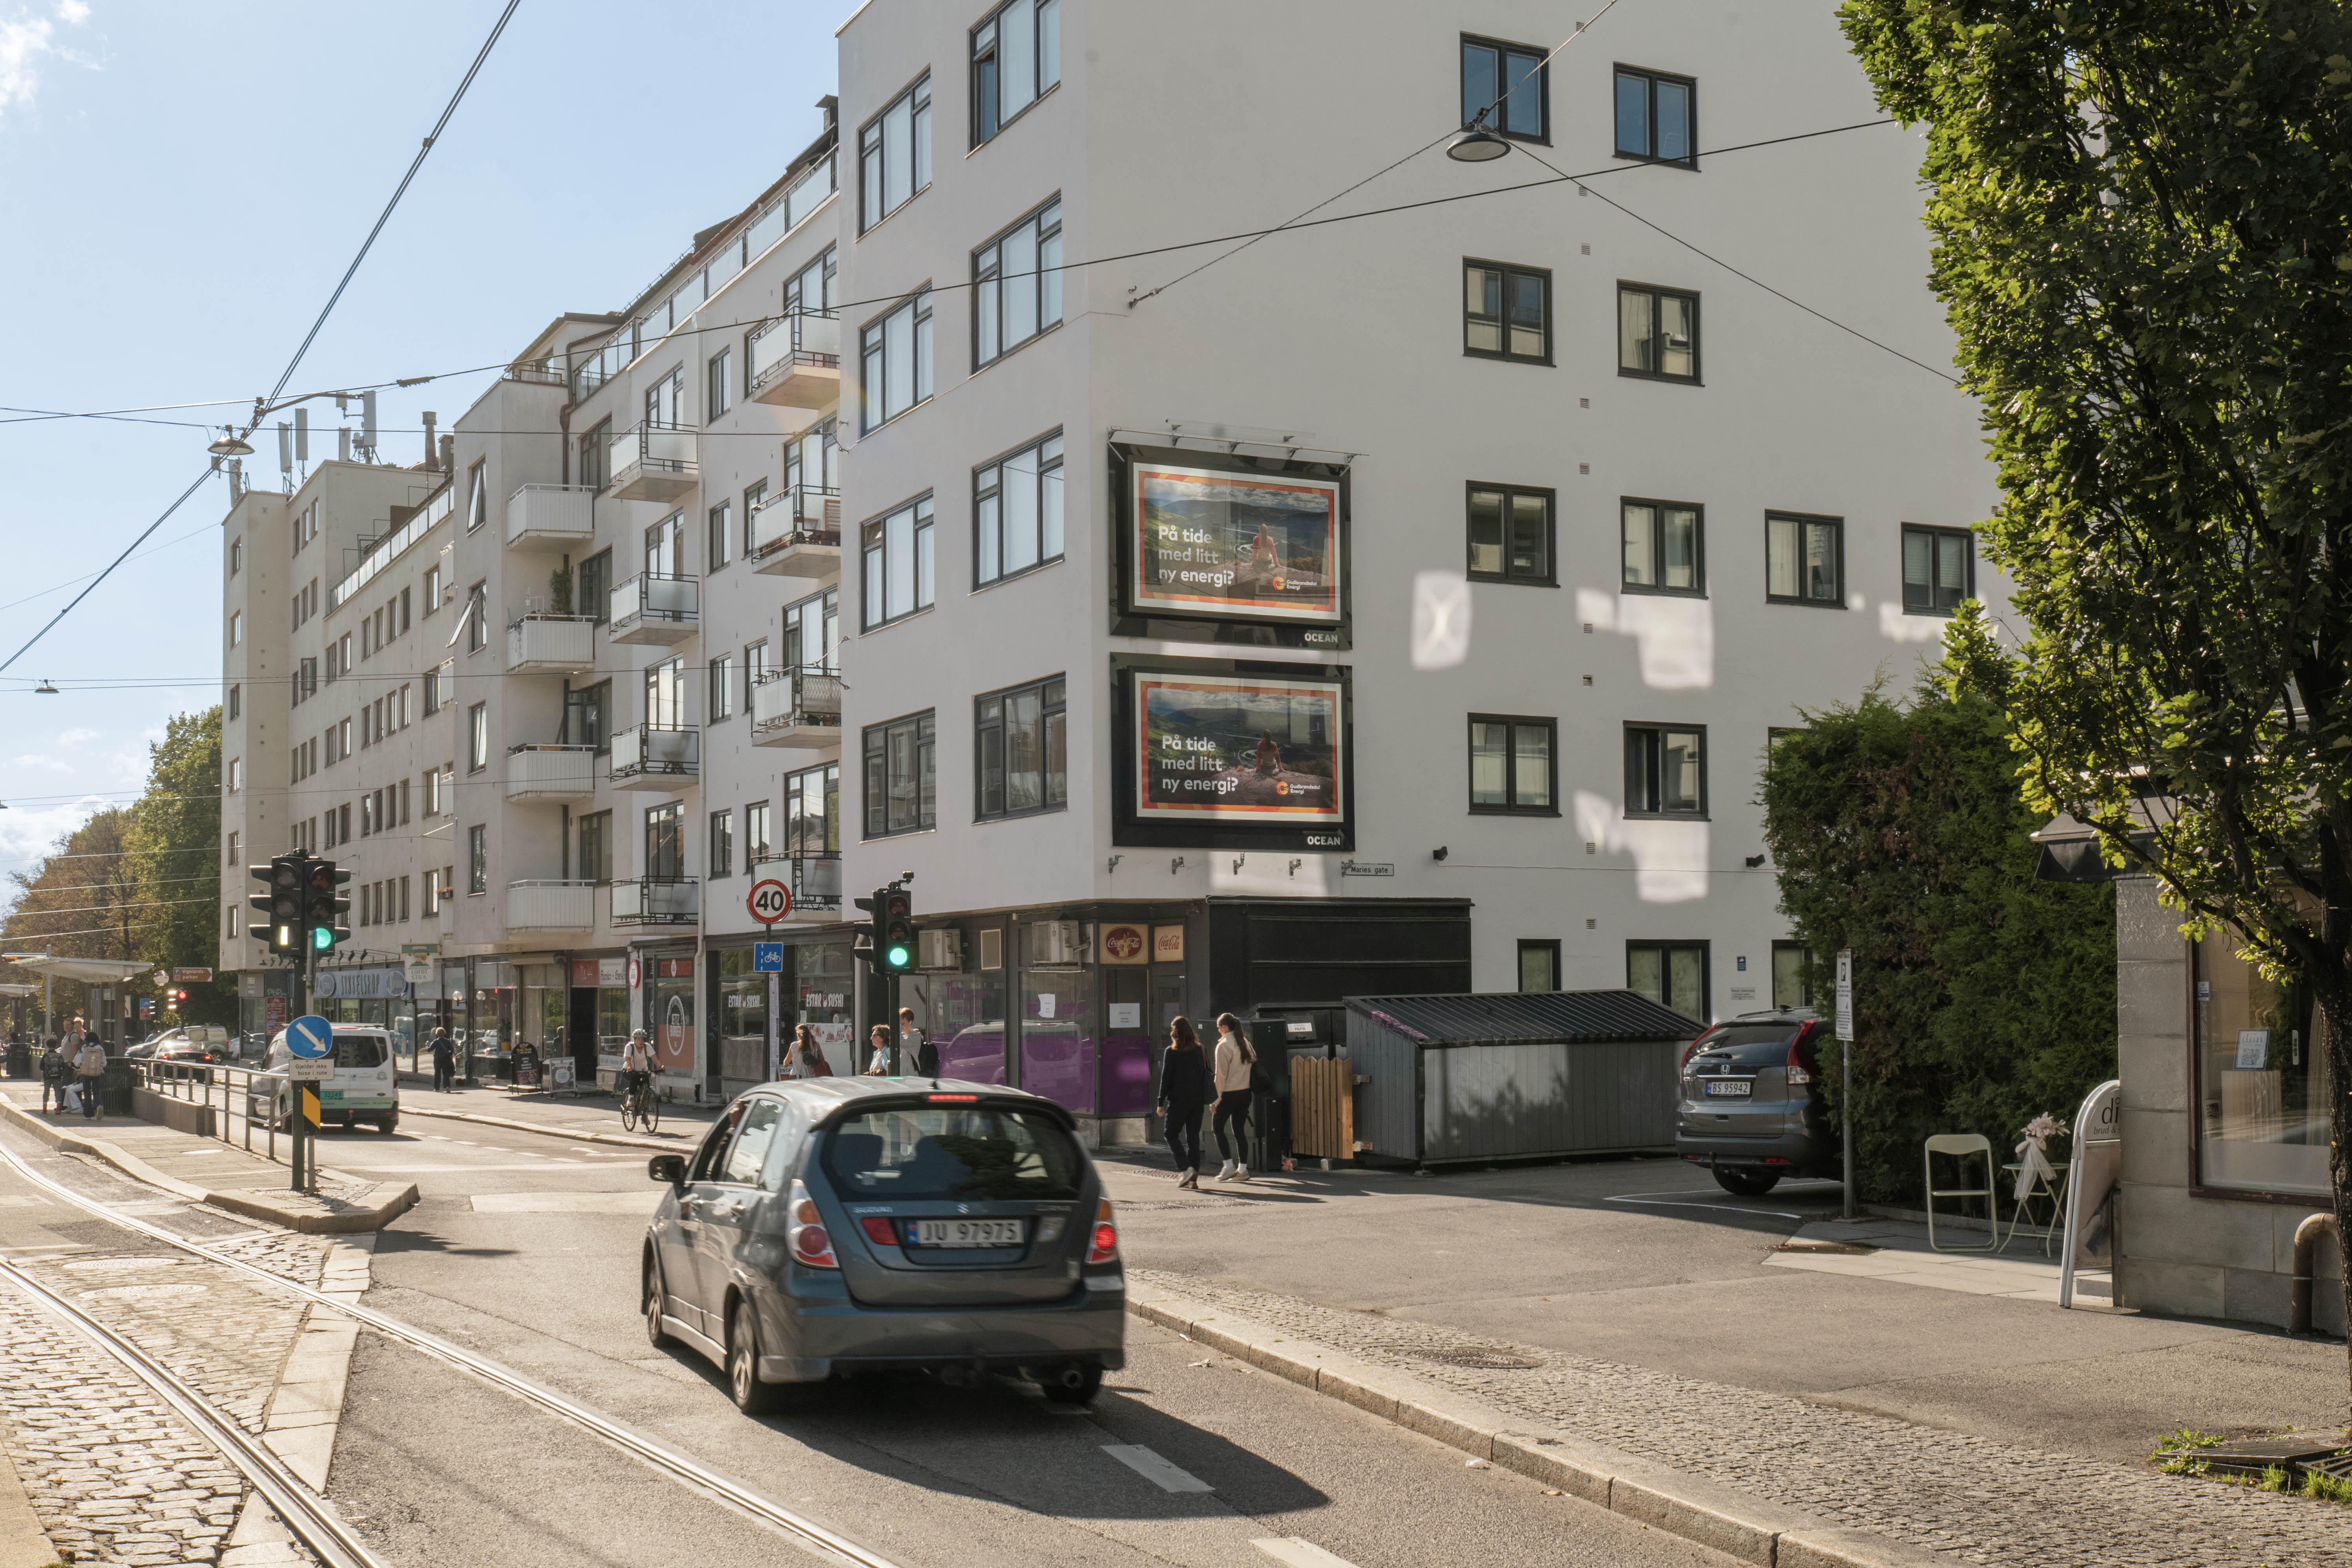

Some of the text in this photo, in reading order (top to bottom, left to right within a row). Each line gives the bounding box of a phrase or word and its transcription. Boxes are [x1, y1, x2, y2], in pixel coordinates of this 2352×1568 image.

[1159, 525, 1212, 544] På tide
[1159, 547, 1218, 564] med litt
[1159, 569, 1234, 587] ny energi?
[1305, 633, 1338, 643] OCEAN
[1162, 734, 1216, 751] På tide
[1162, 756, 1222, 771] med litt
[1163, 777, 1238, 795] ny energi?
[1307, 836, 1340, 845] OCEAN
[755, 890, 784, 911] 40
[728, 995, 760, 1007] ESTAR SUSHI
[806, 993, 844, 1007] ESTAR SUSHI
[1713, 1083, 1748, 1093] BS 95942
[2093, 1125, 2109, 1134] brud
[925, 1223, 1018, 1241] JU 97975
